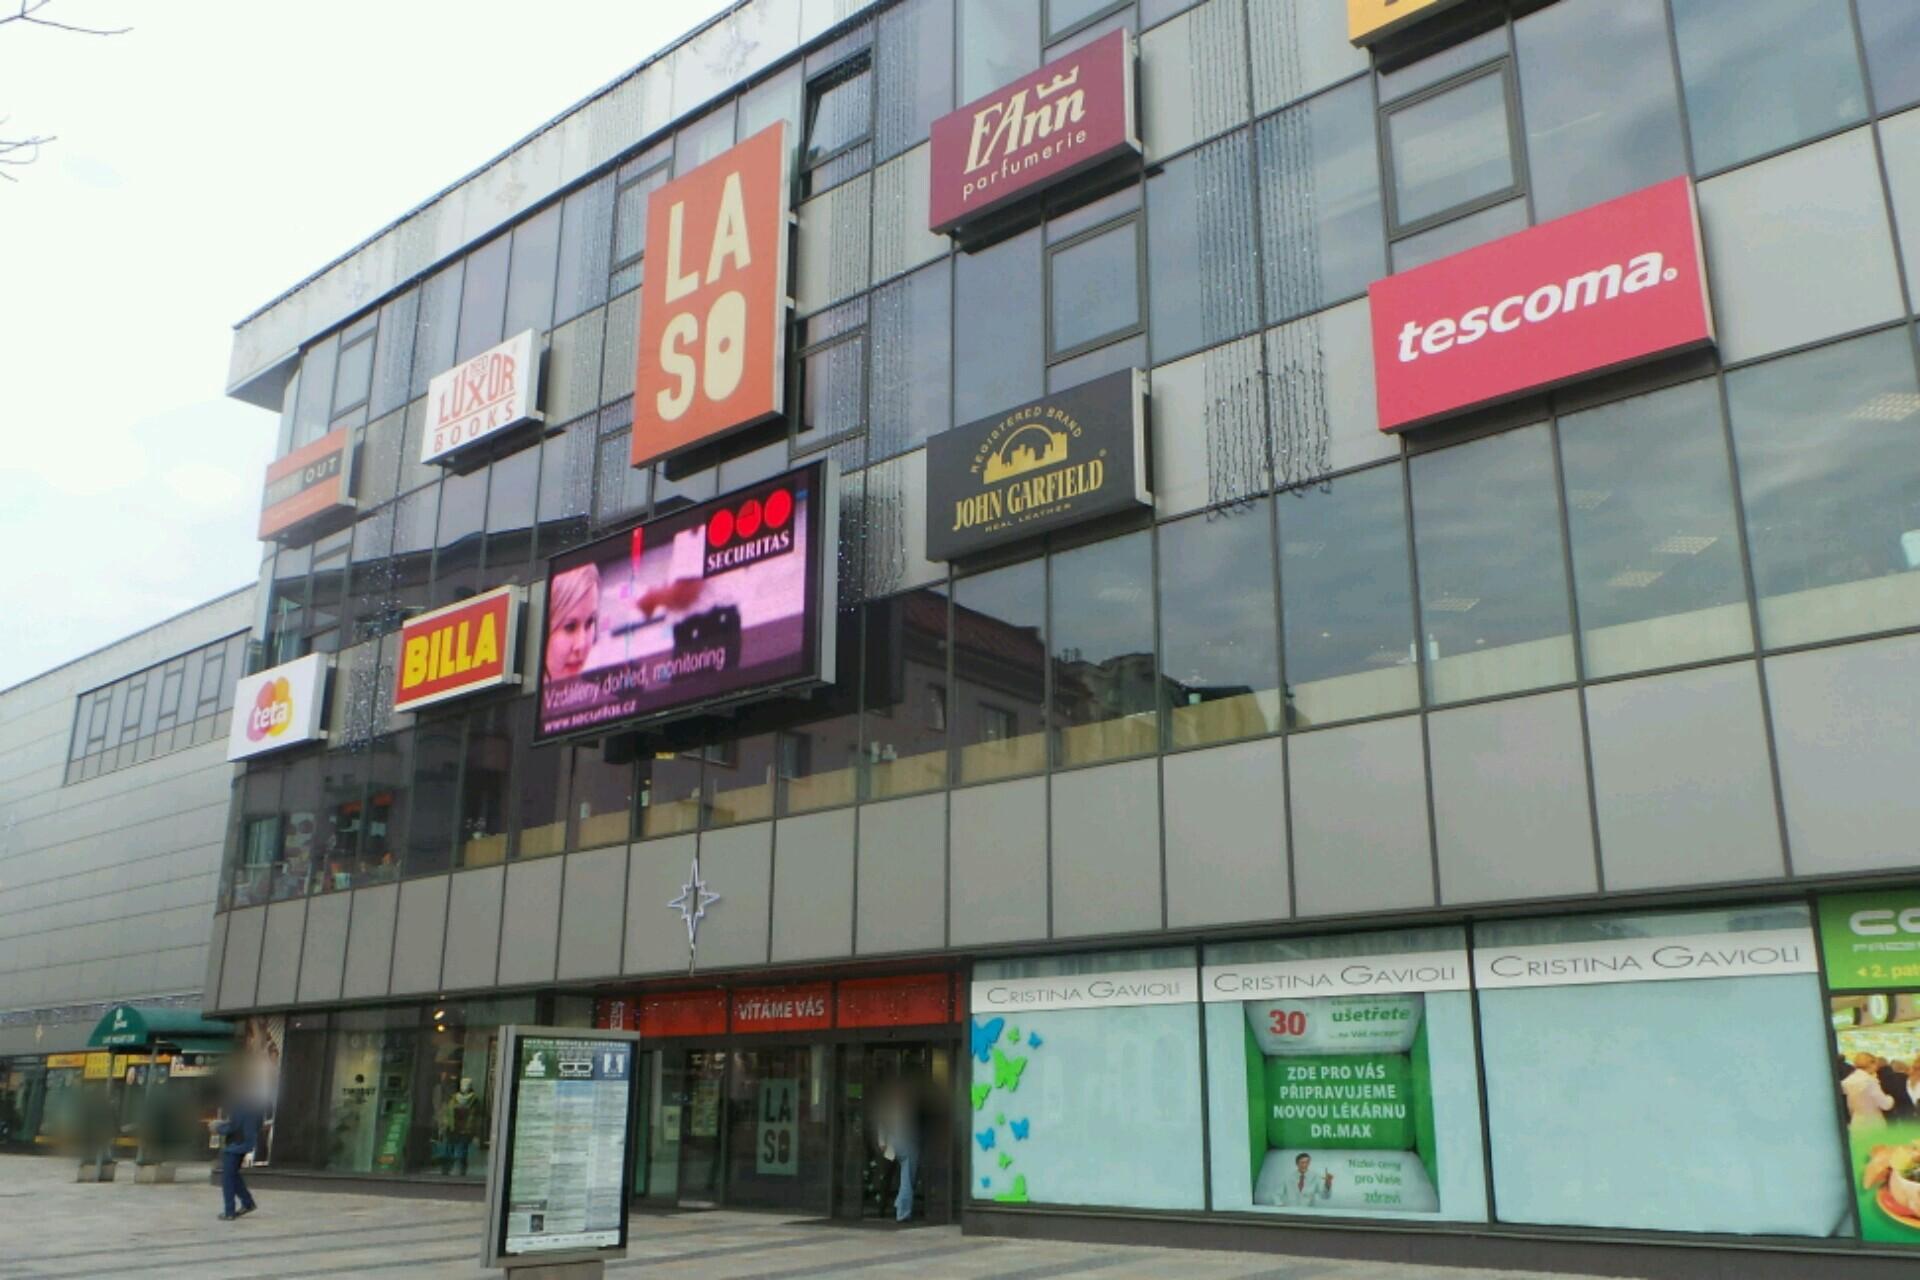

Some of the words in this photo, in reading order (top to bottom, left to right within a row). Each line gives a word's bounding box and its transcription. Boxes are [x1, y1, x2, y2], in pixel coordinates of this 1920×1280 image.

[963, 88, 1086, 175] FAnn
[962, 129, 1087, 200] parfumerie
[665, 170, 752, 304] LA
[656, 290, 747, 422] SO
[438, 353, 515, 425] LUXOR
[434, 400, 514, 453] BOOKS
[970, 405, 1042, 474] REGISTERED
[1047, 406, 1082, 438] BRAND
[305, 457, 338, 483] OUT
[952, 489, 1003, 532] JOHN
[1007, 459, 1104, 515] GARFIELD
[985, 520, 1014, 533] REAL
[1019, 503, 1073, 524] LEATHER
[707, 530, 790, 572] SECURITAS
[402, 612, 498, 689] BILLA
[653, 647, 727, 682] monitoring
[252, 700, 288, 727] teta
[544, 700, 637, 732] www.securitas.cz
[1214, 972, 1333, 992] CRISTINA
[1341, 965, 1456, 986] GAVIOLI
[1491, 955, 1643, 978] CRISTINA
[1652, 946, 1800, 969] GAVIOLI
[1269, 1009, 1307, 1036] 30
[1287, 1067, 1317, 1081] ZDE
[1321, 1067, 1351, 1080] PRO
[1355, 1063, 1386, 1079] VÁS
[764, 1087, 792, 1123] LA
[1280, 1083, 1397, 1099] PŘIPRAVUJEME
[1273, 1105, 1329, 1119] NOVOU
[1332, 1102, 1406, 1119] LÉKÁRNU
[763, 1128, 792, 1164] SO
[1311, 1123, 1372, 1138] DR.MAX
